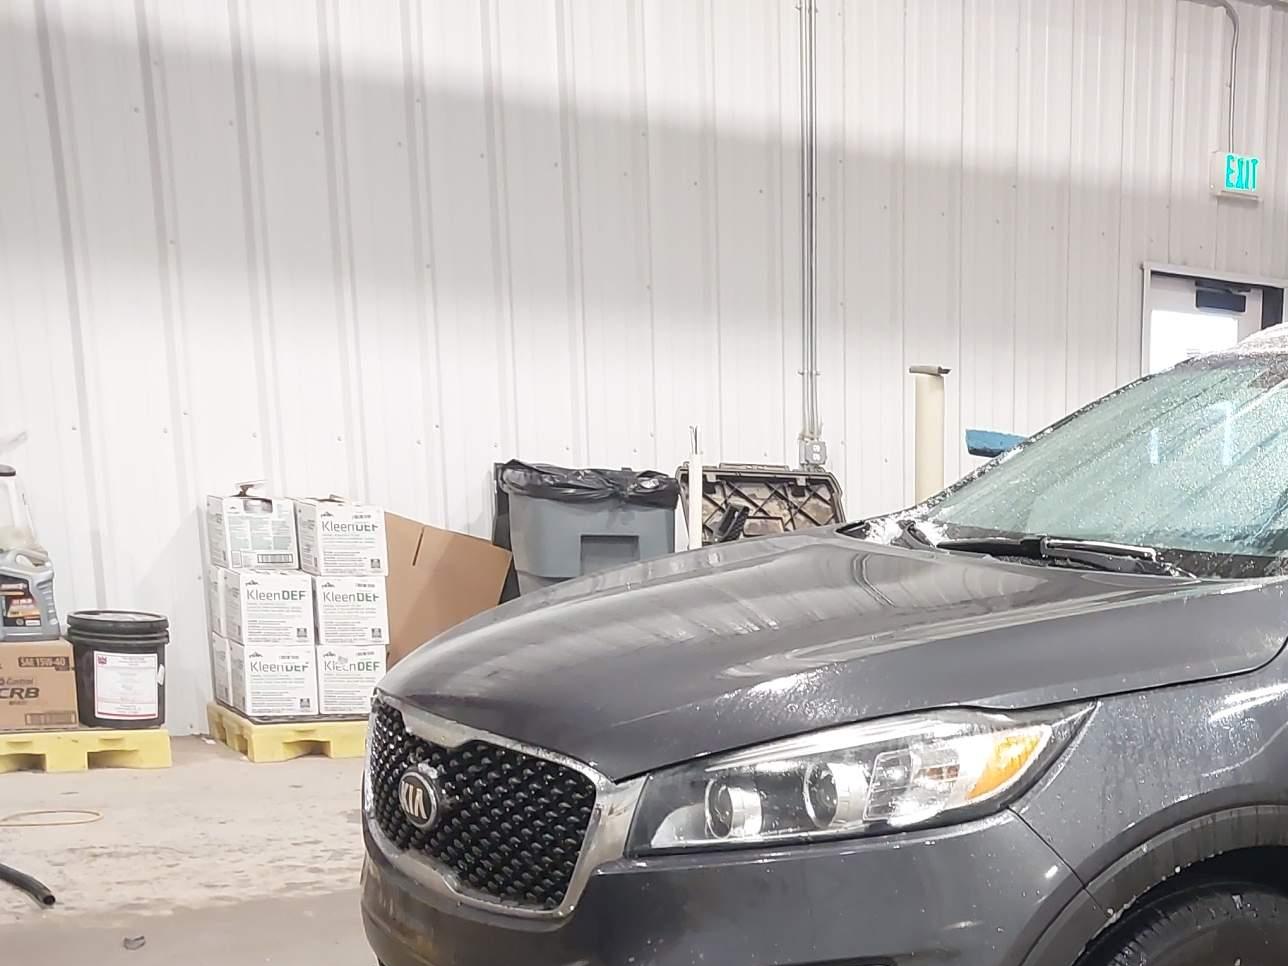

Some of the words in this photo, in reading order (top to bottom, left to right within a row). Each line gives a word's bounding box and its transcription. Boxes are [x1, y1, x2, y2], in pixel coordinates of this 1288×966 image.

[1225, 154, 1259, 190] EXIT
[246, 590, 307, 601] KleenDEF
[323, 591, 379, 602] KleenDEF
[250, 661, 309, 673] KleenDEF
[400, 781, 428, 819] KIA
